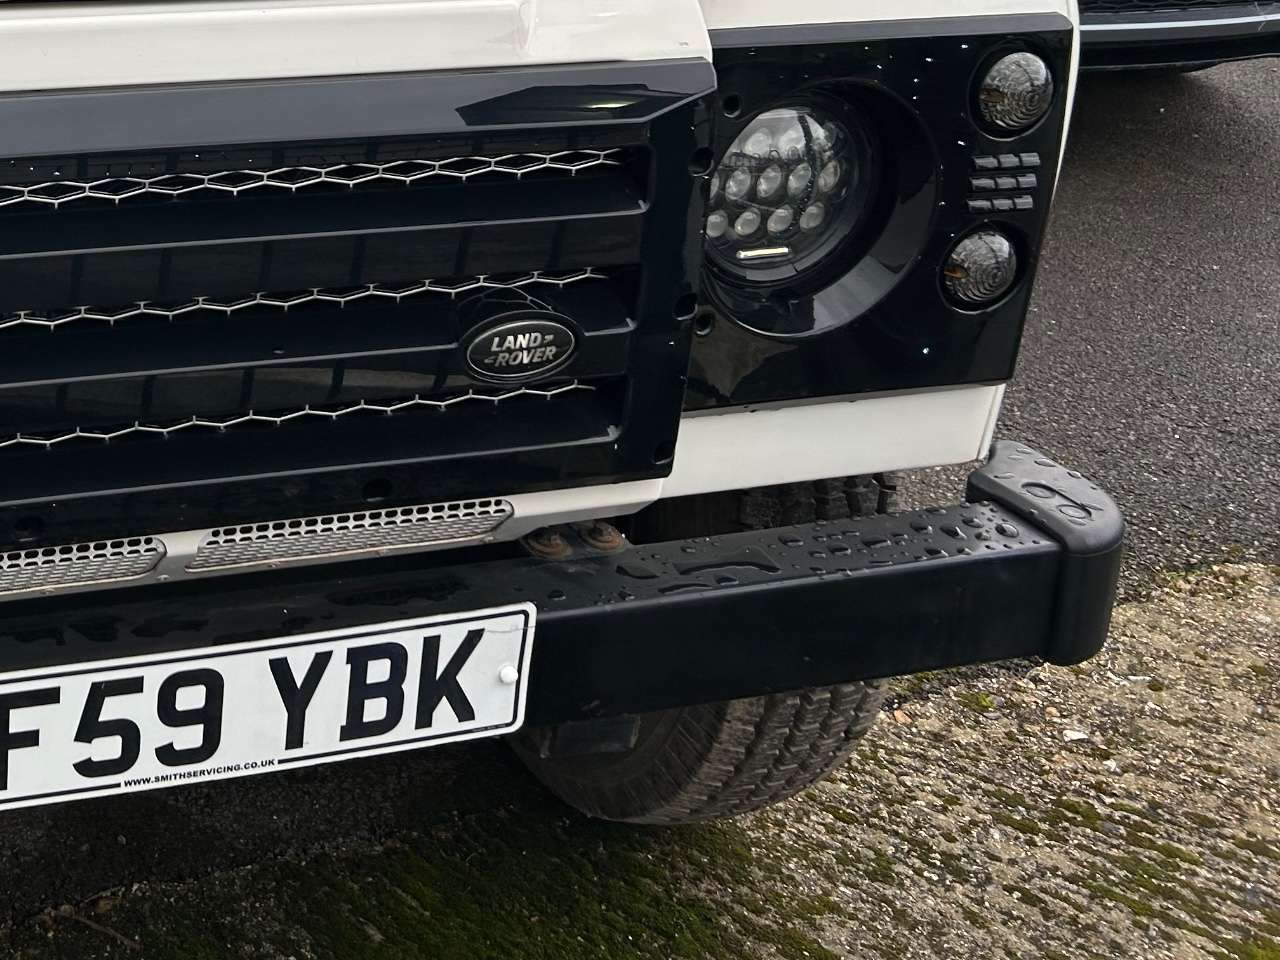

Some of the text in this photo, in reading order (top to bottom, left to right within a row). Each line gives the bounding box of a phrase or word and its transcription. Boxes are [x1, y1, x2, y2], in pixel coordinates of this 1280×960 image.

[491, 332, 542, 352] LAND
[495, 346, 557, 367] ROVER
[267, 627, 487, 750] YBK
[124, 758, 275, 788] WWW.SMITHSERVICING.CO.UK
